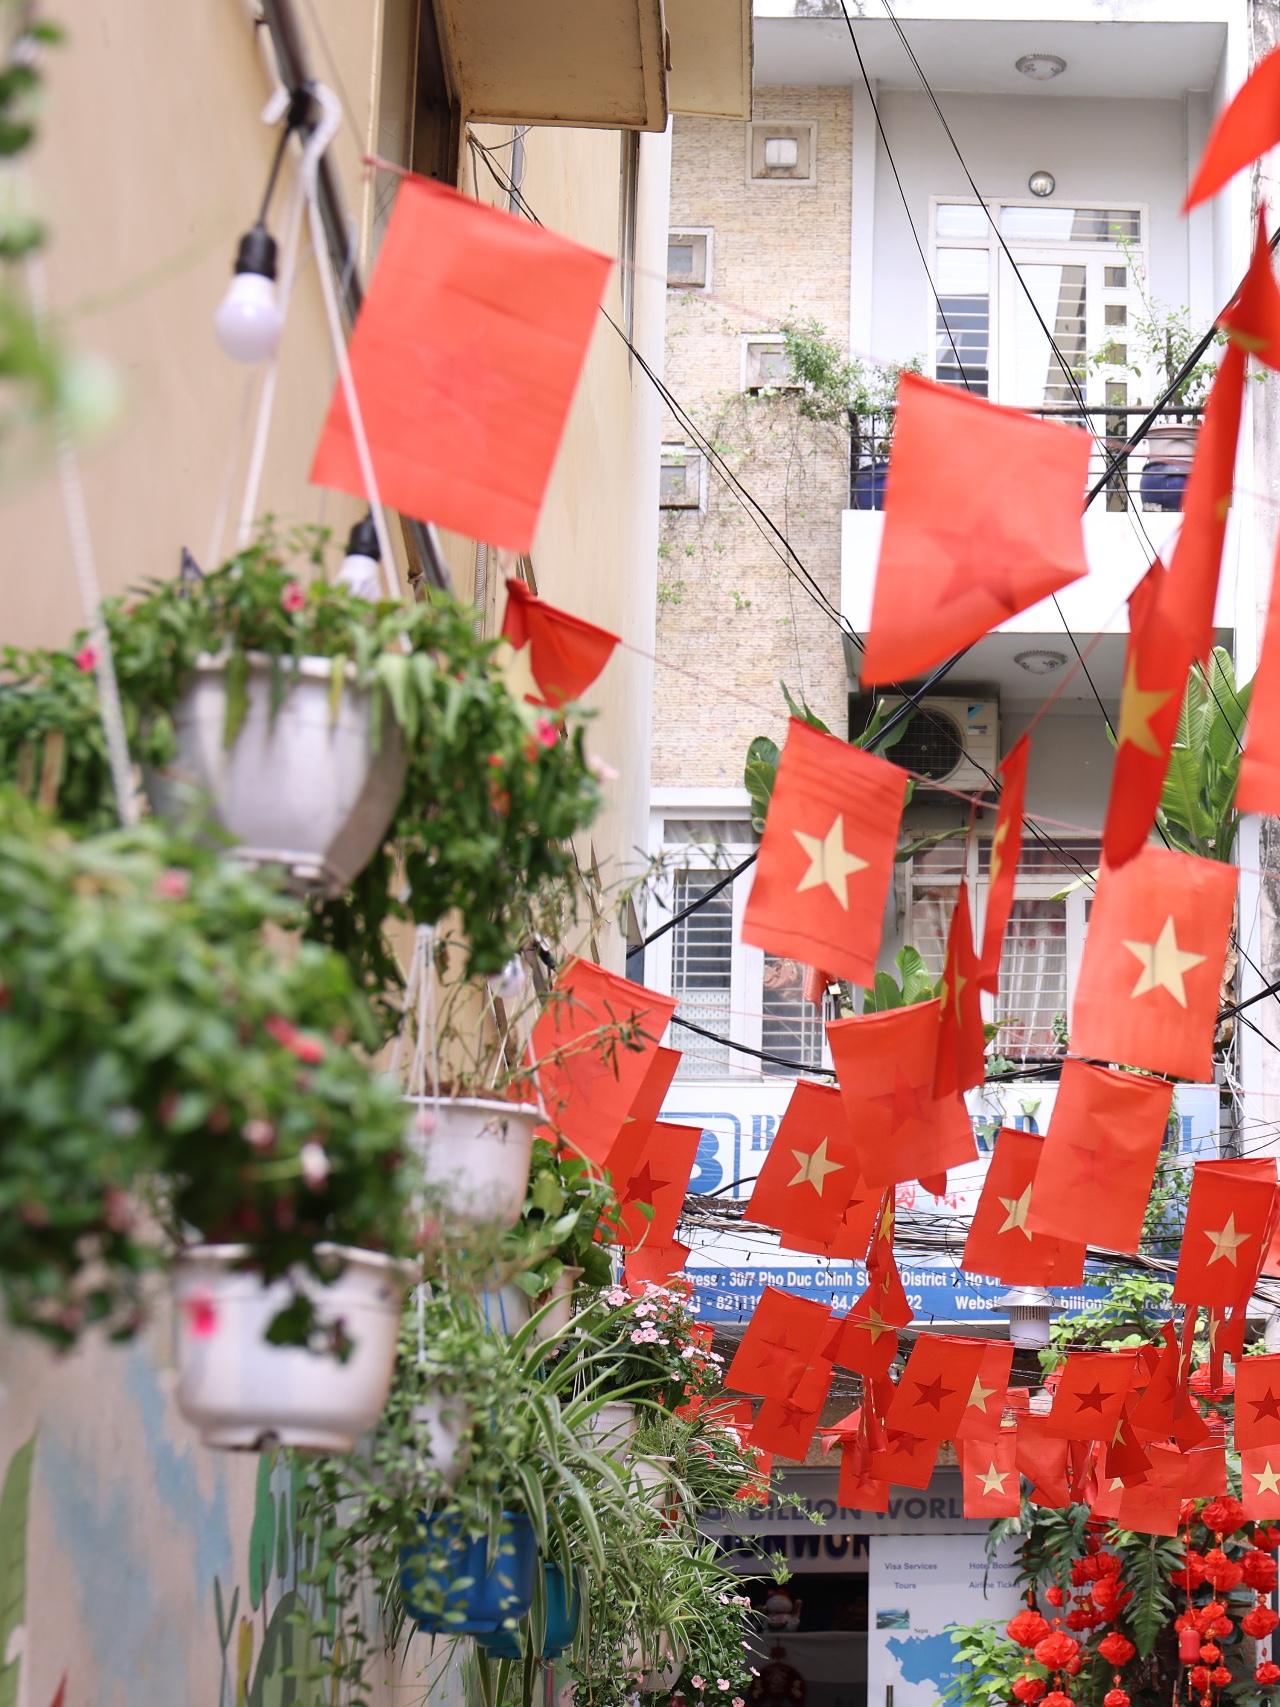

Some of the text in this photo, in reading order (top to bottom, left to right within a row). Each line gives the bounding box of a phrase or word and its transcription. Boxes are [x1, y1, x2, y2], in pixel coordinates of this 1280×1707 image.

[729, 1271, 756, 1287] 30/7
[758, 1271, 784, 1287] Pho
[787, 1271, 812, 1287] Duc
[815, 1271, 852, 1287] Chinh
[901, 1271, 947, 1287] District
[874, 1497, 963, 1520] WORL
[885, 1562, 938, 1570] Visa Services
[894, 1581, 916, 1590] Tours
